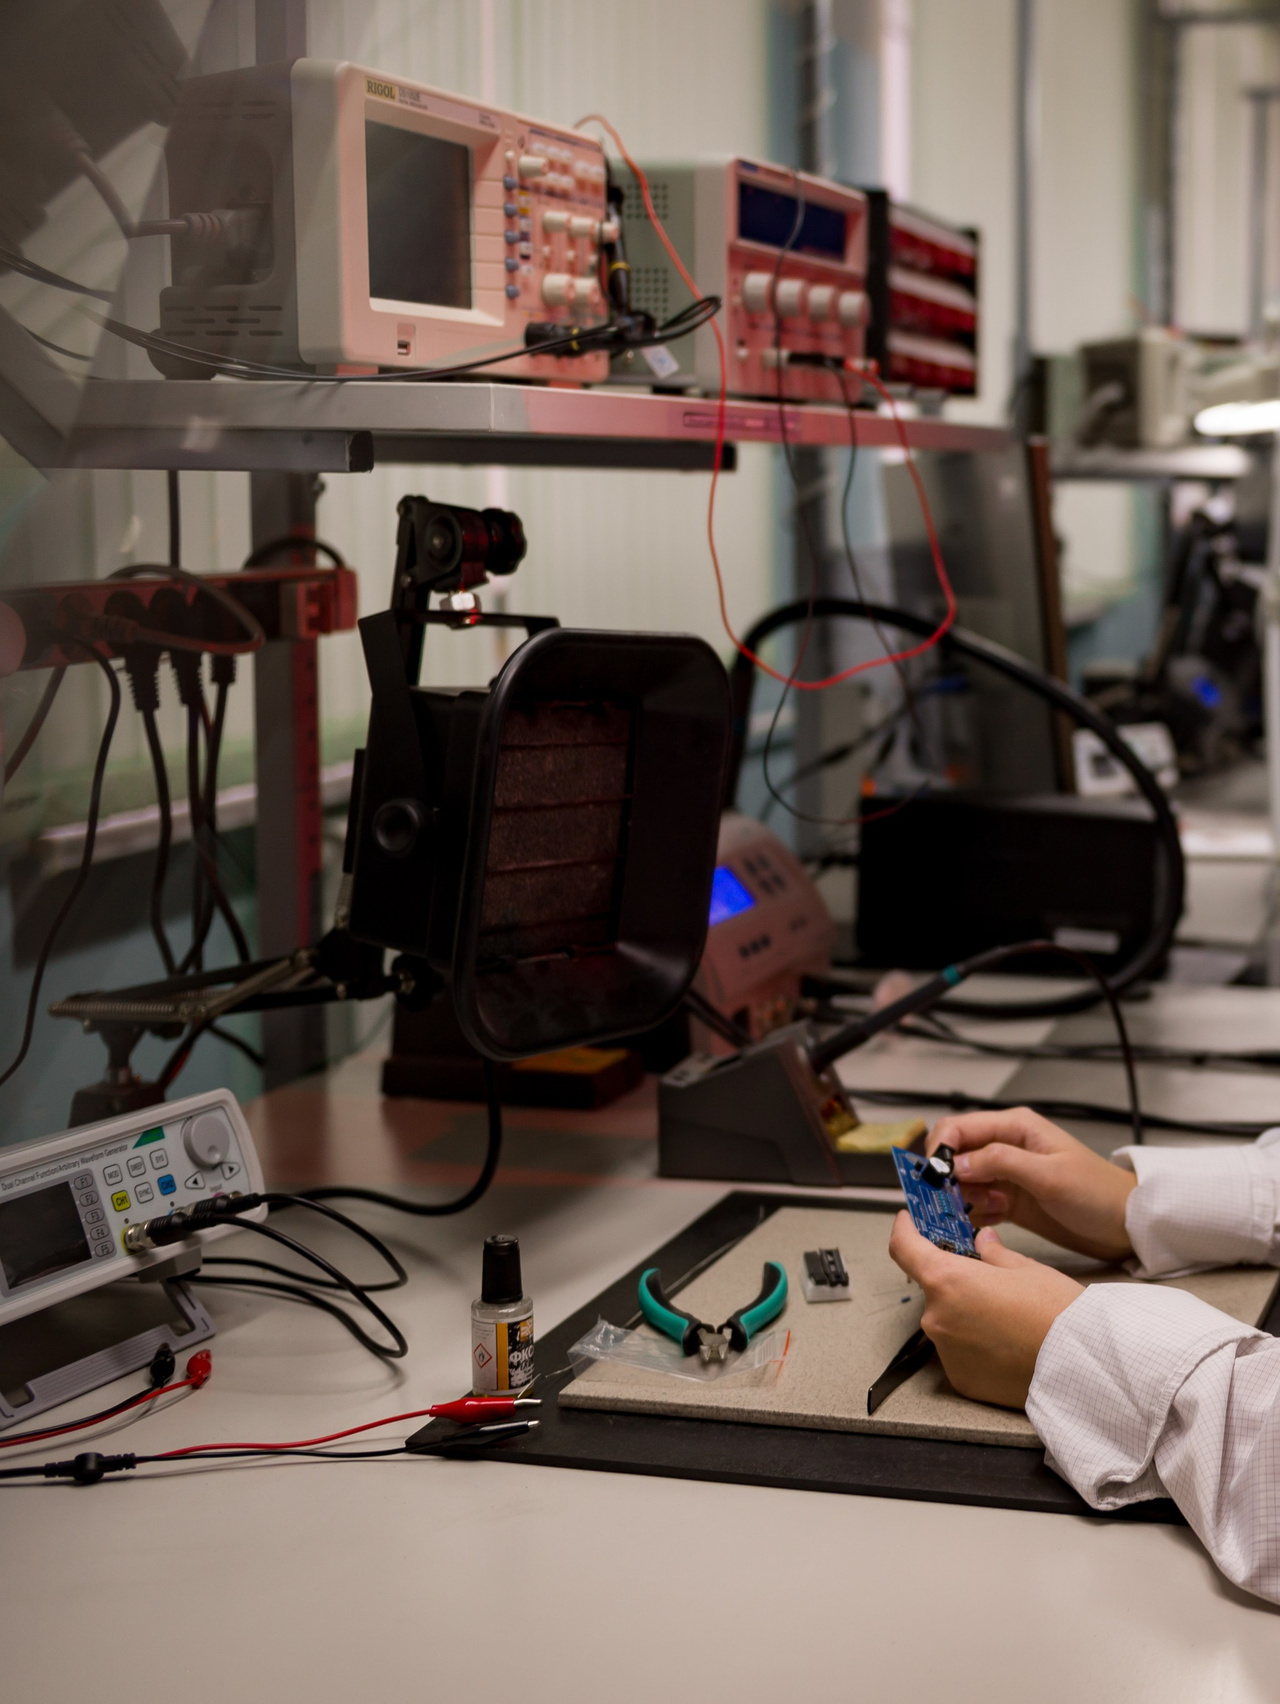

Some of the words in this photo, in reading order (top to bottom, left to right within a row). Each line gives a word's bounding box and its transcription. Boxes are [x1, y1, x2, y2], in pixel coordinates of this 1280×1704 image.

[367, 80, 396, 100] RIGOL
[1, 1181, 14, 1191] Dual
[14, 1174, 36, 1187] Channel
[81, 1151, 104, 1165] Waveform
[104, 1143, 128, 1157] Generator
[107, 1169, 120, 1180] MOD
[80, 1176, 89, 1187] F1
[161, 1179, 174, 1191] CH2
[85, 1193, 94, 1204] F2
[115, 1195, 129, 1207] CH1
[90, 1211, 100, 1221] F3
[96, 1227, 105, 1238] F4
[100, 1243, 110, 1254] F5
